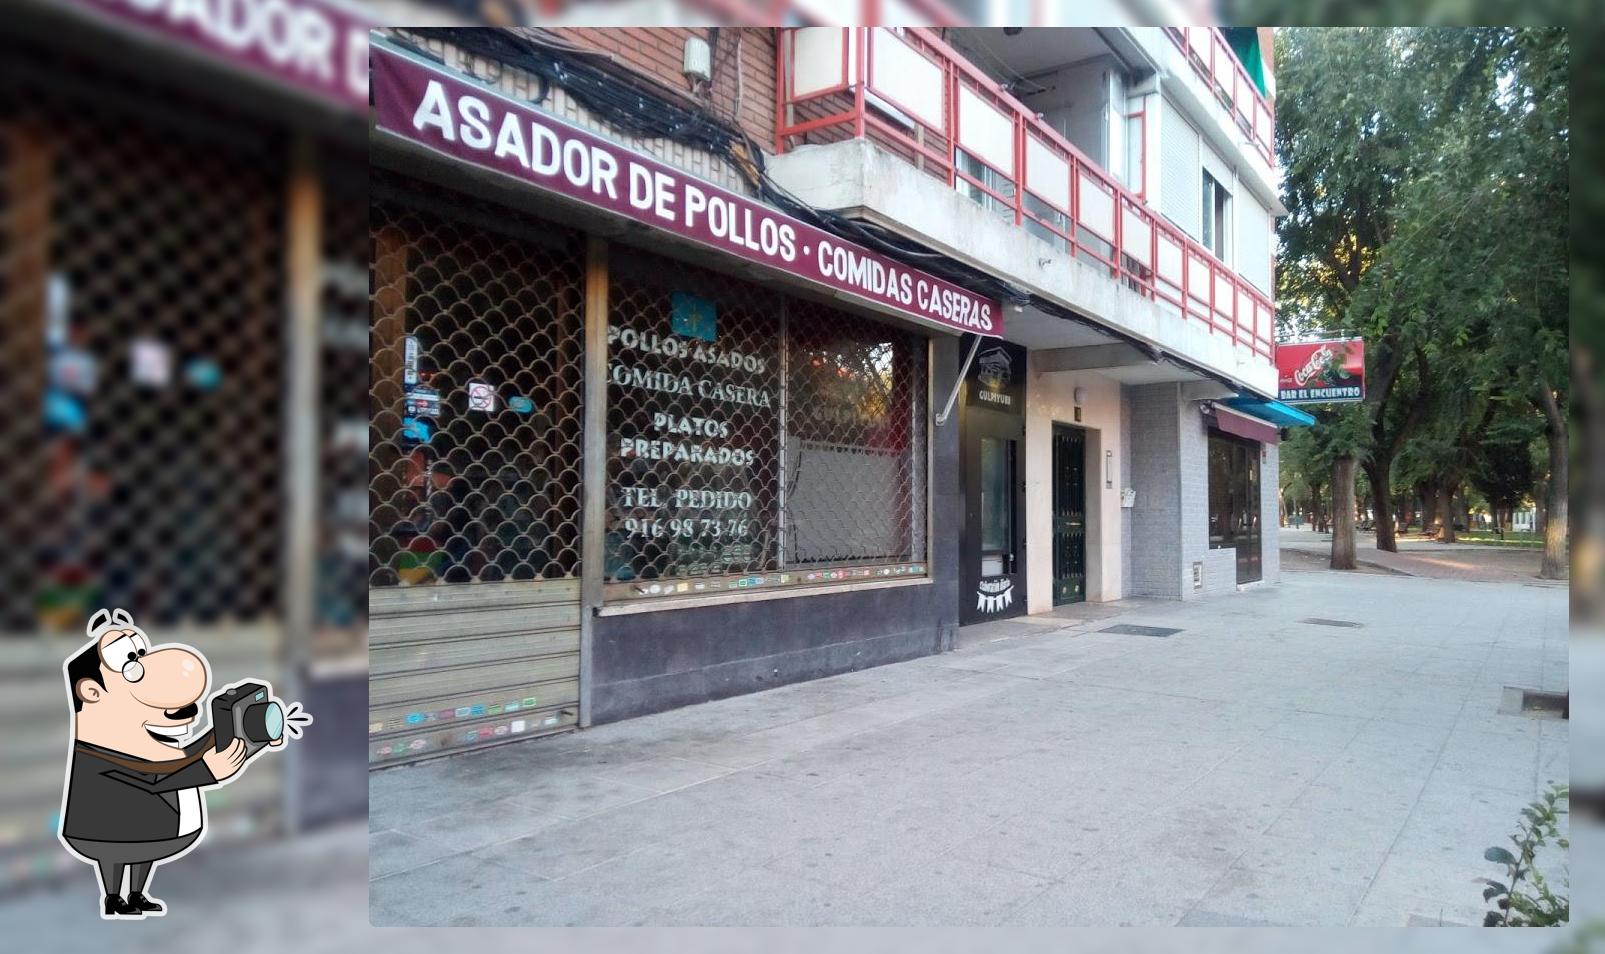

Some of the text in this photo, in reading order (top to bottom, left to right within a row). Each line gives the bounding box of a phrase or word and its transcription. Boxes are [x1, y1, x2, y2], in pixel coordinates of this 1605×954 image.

[412, 79, 619, 200] ASADOR
[628, 161, 676, 216] DE
[684, 183, 797, 262] POLLOS
[817, 239, 913, 306] COMIDAS
[917, 279, 994, 331] CASERAS
[693, 345, 766, 374] ASADOS
[607, 363, 771, 409] OMIDA CASERA
[1280, 386, 1360, 400] BAR EL ENCUENTRO
[654, 412, 729, 439] PLATOS
[620, 437, 754, 466] PREPARADOS
[675, 489, 752, 510] PEDIDO
[670, 518, 694, 538] 98
[701, 518, 721, 537] 73
